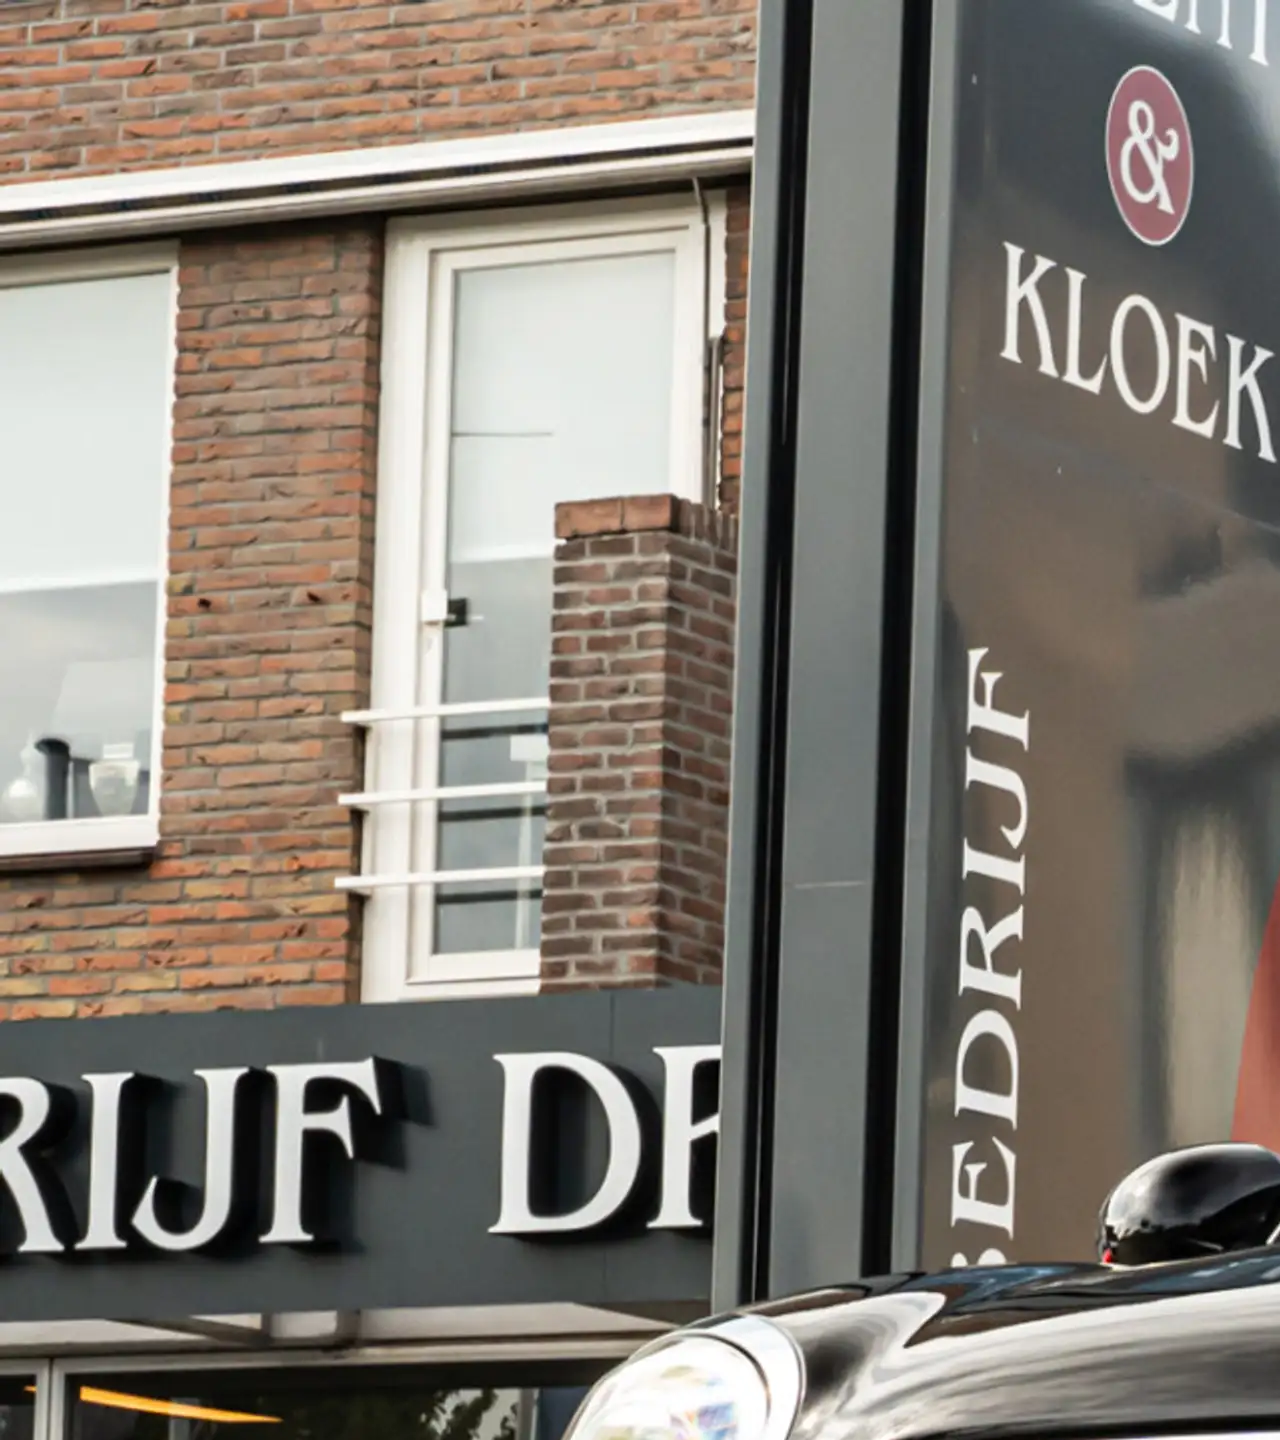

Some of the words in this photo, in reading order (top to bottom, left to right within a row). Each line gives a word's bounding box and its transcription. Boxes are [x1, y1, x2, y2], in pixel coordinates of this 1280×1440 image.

[1119, 100, 1179, 214] &
[1000, 241, 1277, 464] KLOEK
[951, 647, 1029, 1267] EDRIJF
